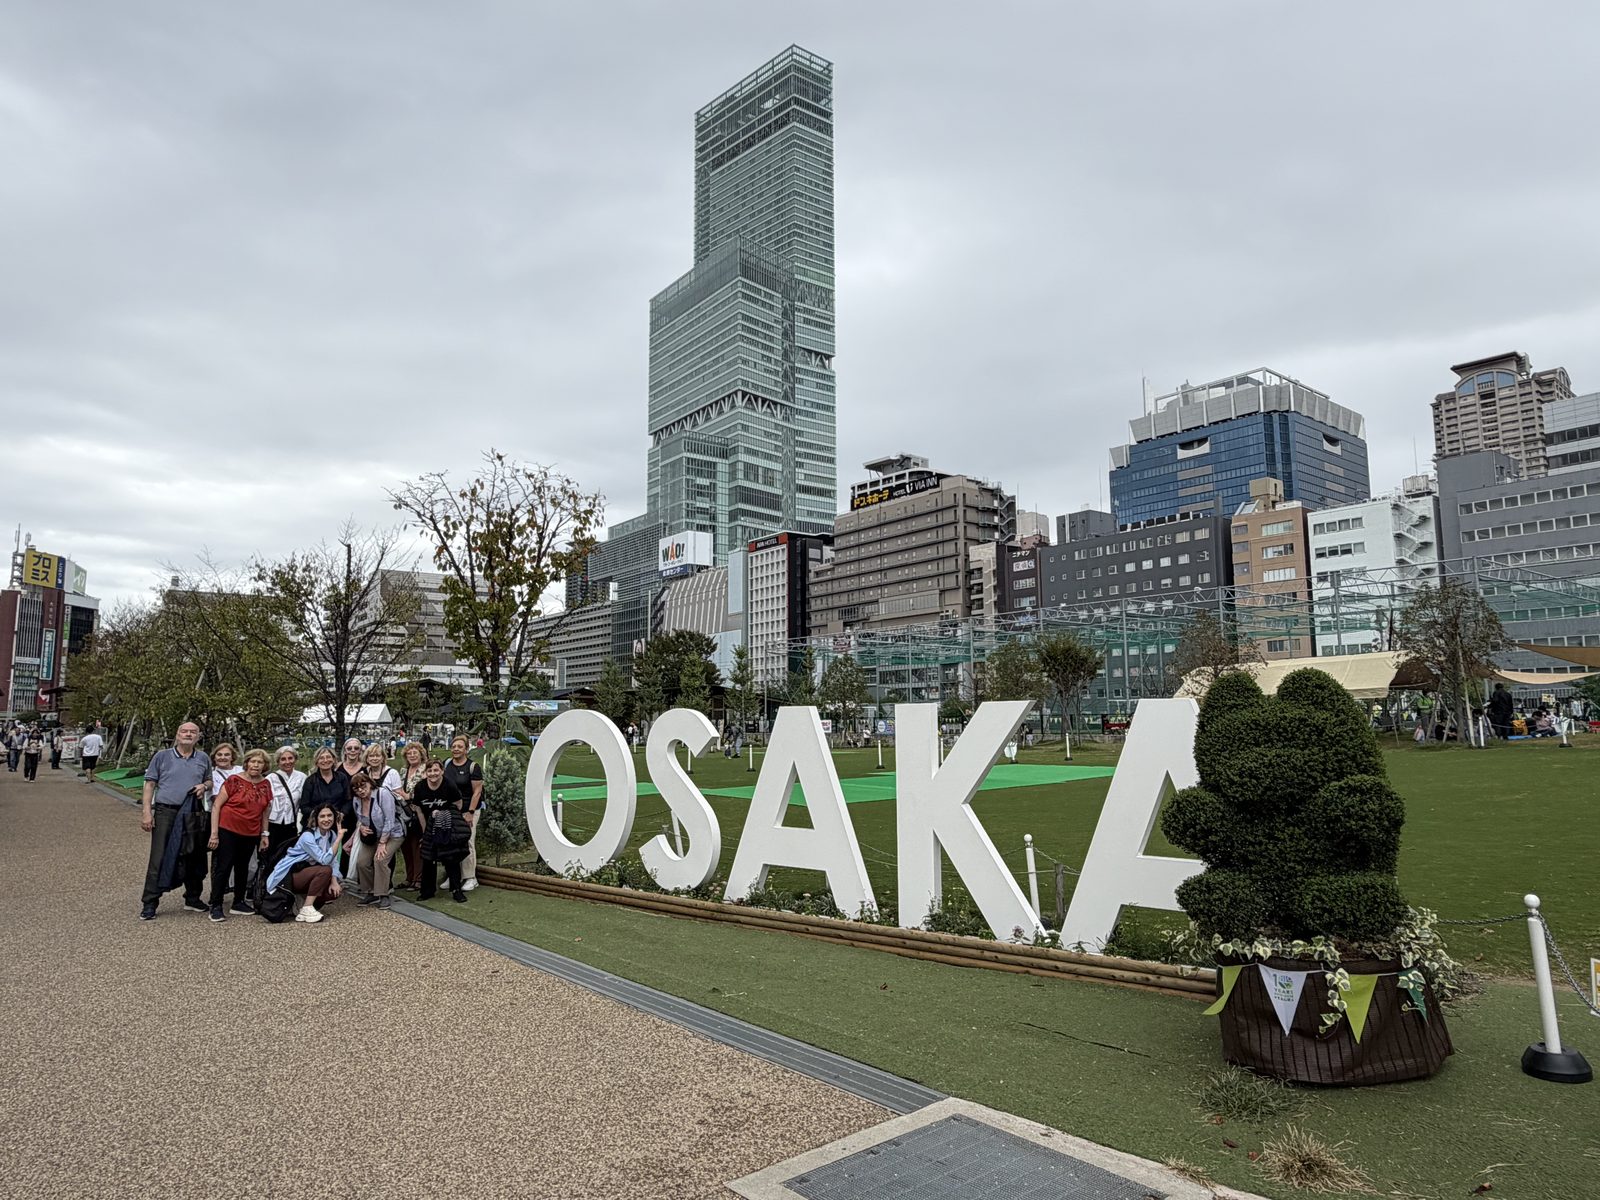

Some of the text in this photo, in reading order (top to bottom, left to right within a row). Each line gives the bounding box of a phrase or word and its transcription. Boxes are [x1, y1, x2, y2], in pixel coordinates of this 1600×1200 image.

[926, 476, 938, 488] INN
[765, 538, 777, 546] HOTEL
[32, 554, 52, 569] プロ
[31, 568, 50, 583] ミス
[525, 698, 1207, 953] OSAKA
